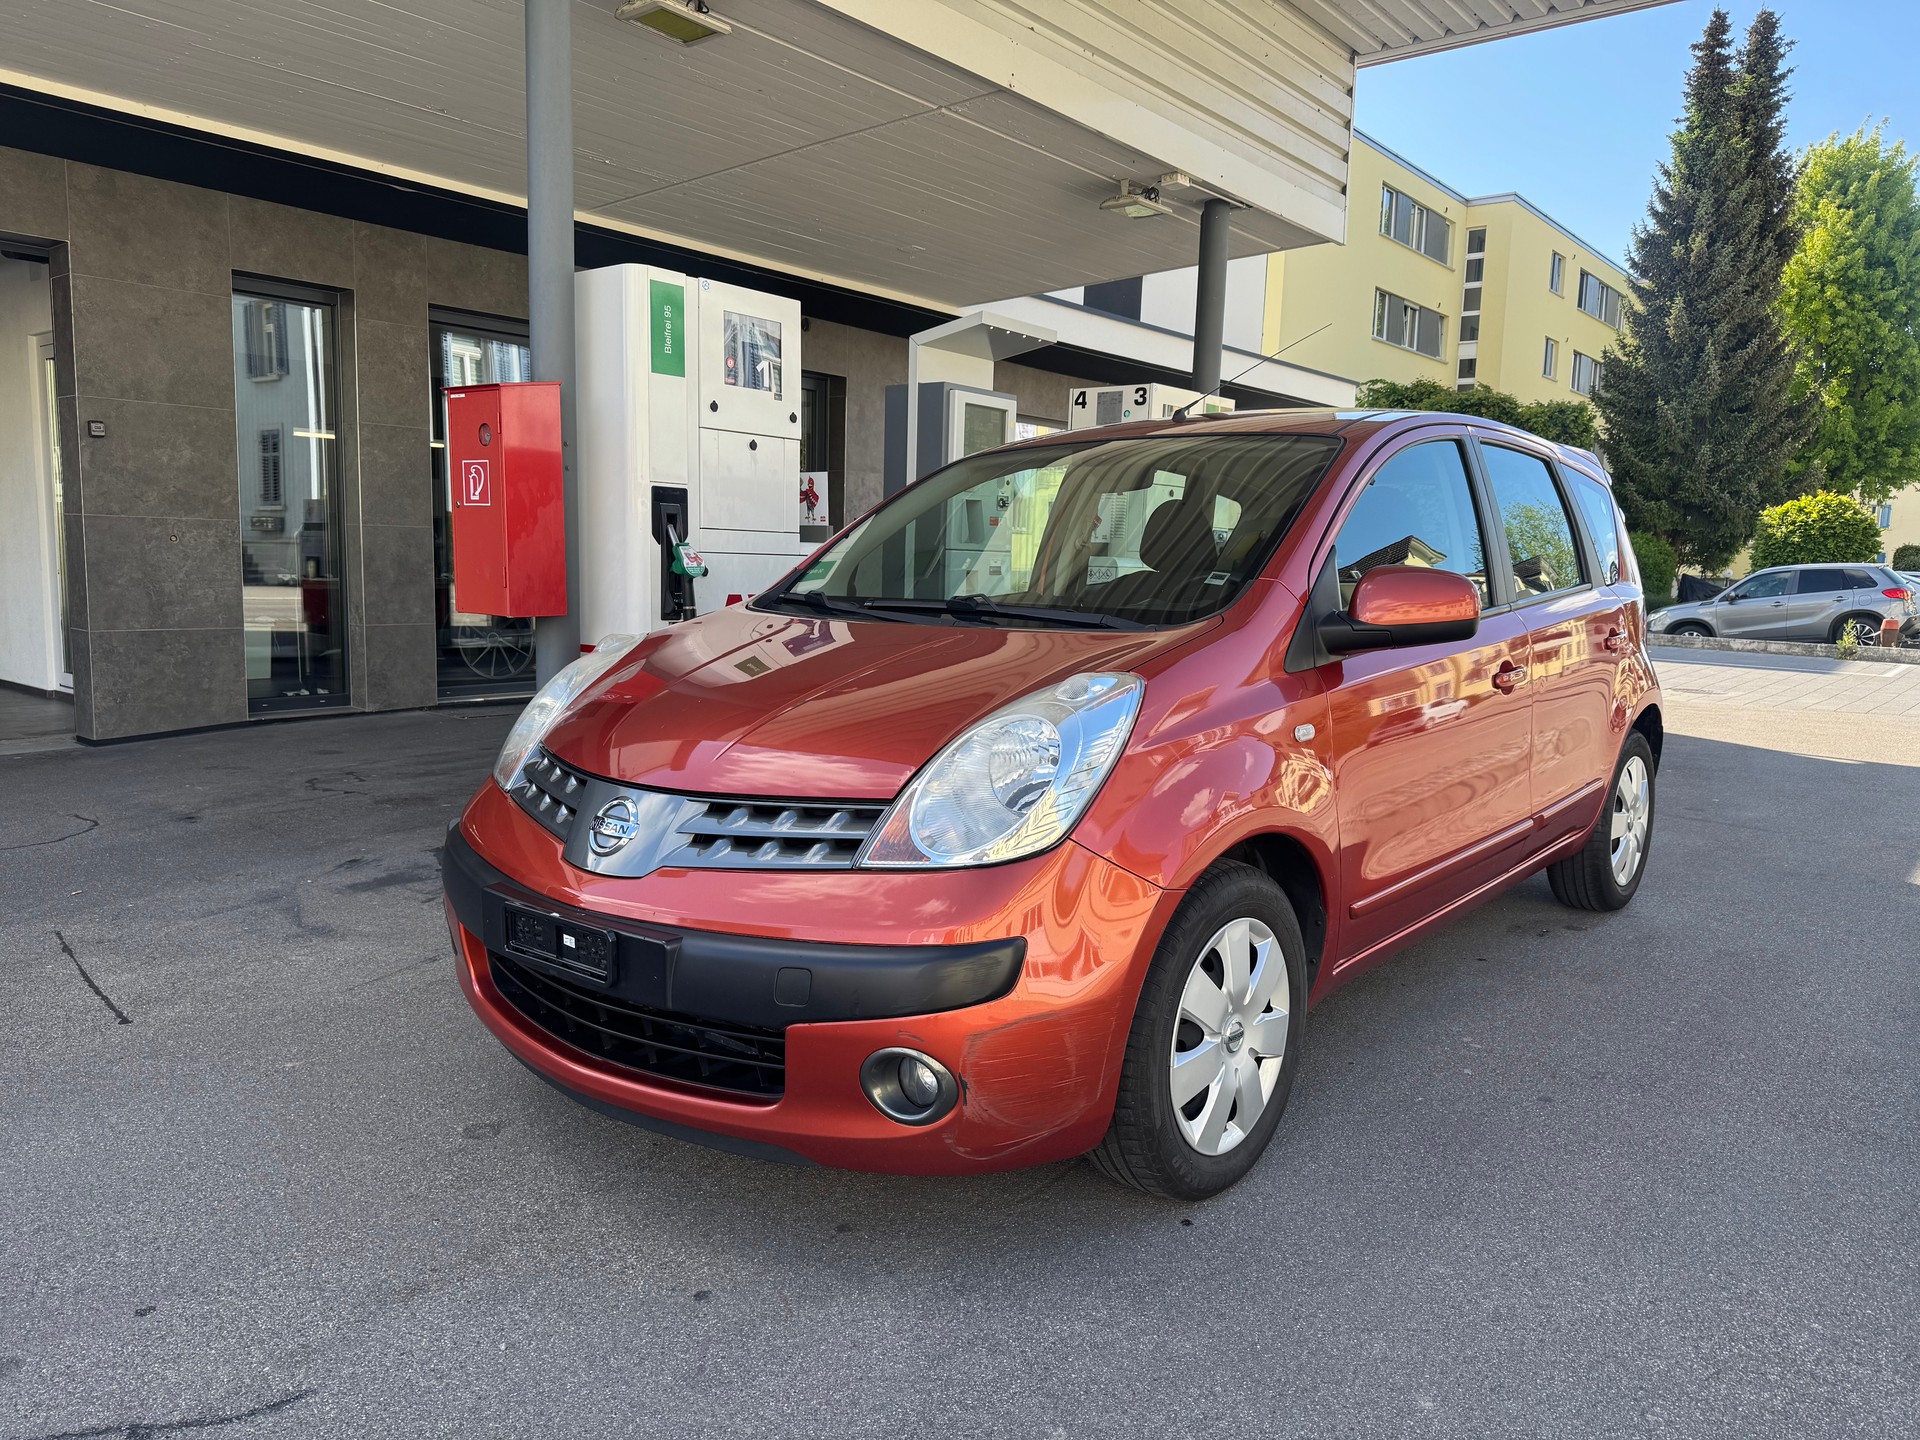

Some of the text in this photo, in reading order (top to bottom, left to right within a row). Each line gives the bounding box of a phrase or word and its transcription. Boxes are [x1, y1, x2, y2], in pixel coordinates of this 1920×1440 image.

[664, 304, 672, 354] Bleifrei 95
[755, 360, 769, 387] 1
[1074, 390, 1087, 409] 4
[1134, 387, 1147, 406] 3
[591, 818, 630, 834] NISSAN
